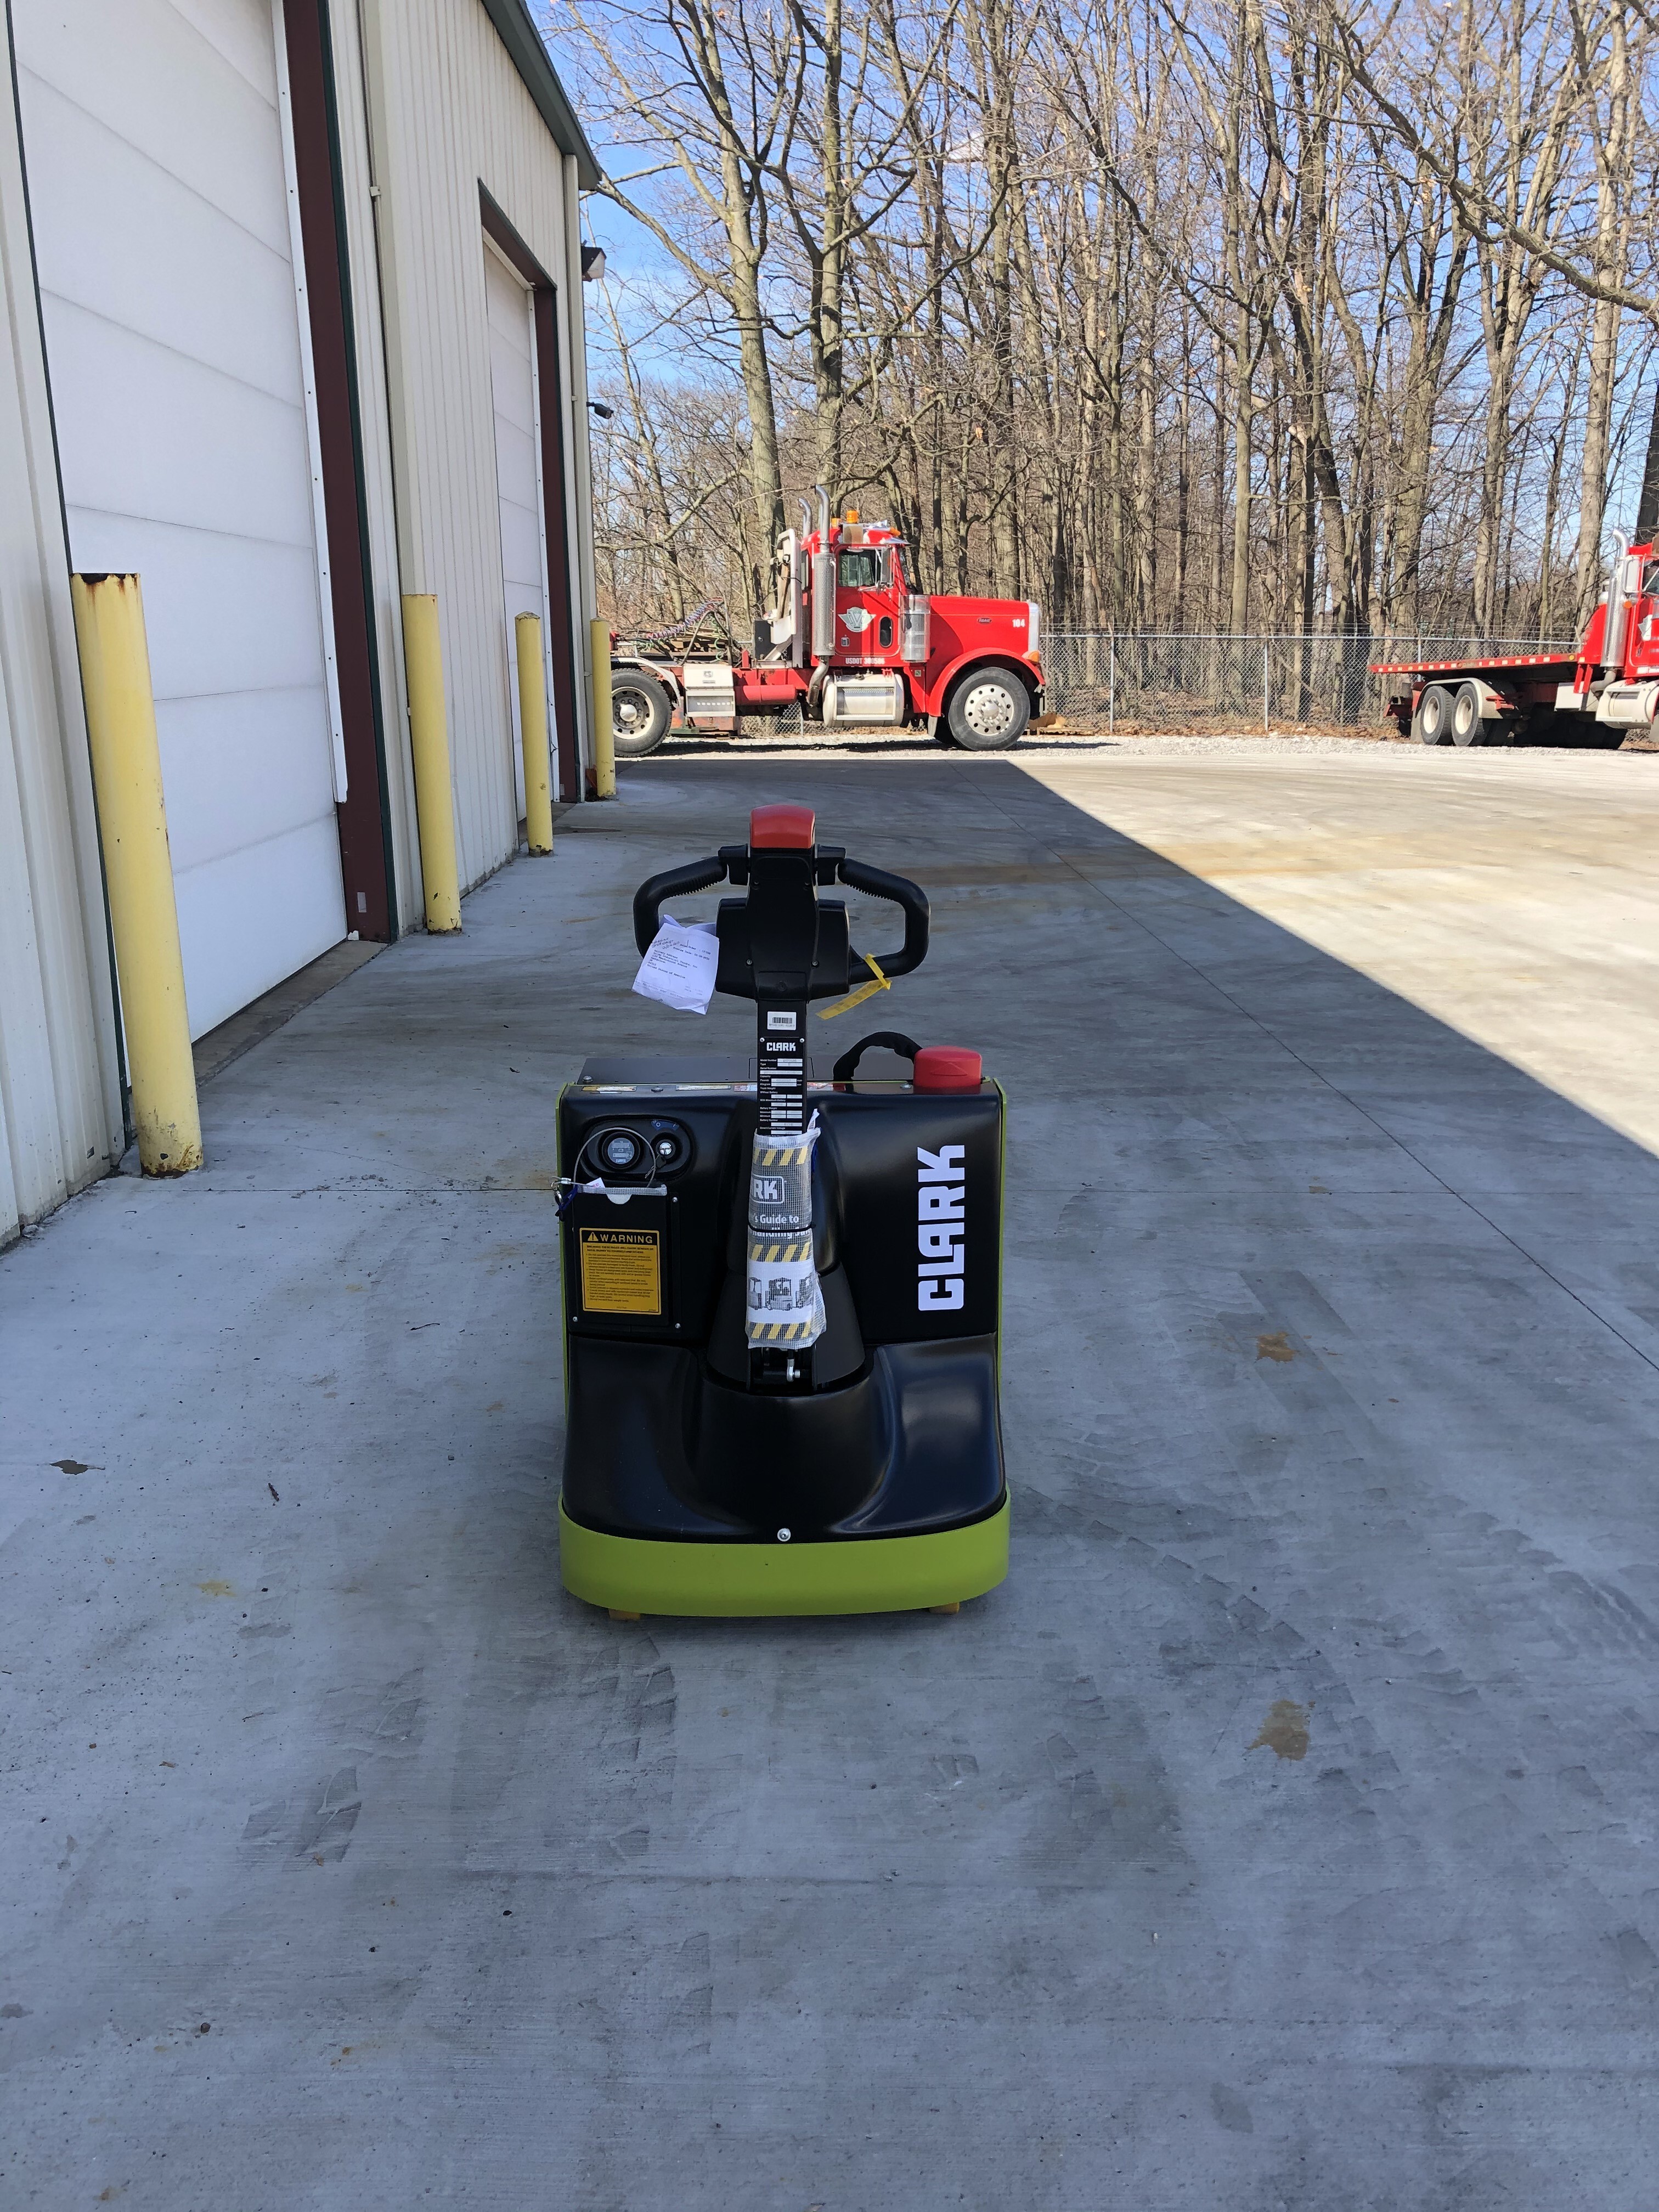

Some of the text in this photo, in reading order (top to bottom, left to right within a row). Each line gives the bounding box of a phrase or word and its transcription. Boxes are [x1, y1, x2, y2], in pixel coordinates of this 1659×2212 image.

[1012, 618, 1025, 628] 104
[766, 1042, 796, 1052] CLARK
[760, 1214, 787, 1224] Guide
[789, 1214, 799, 1223] to
[917, 1144, 965, 1311] CLARK
[600, 1233, 653, 1244] WARNING
